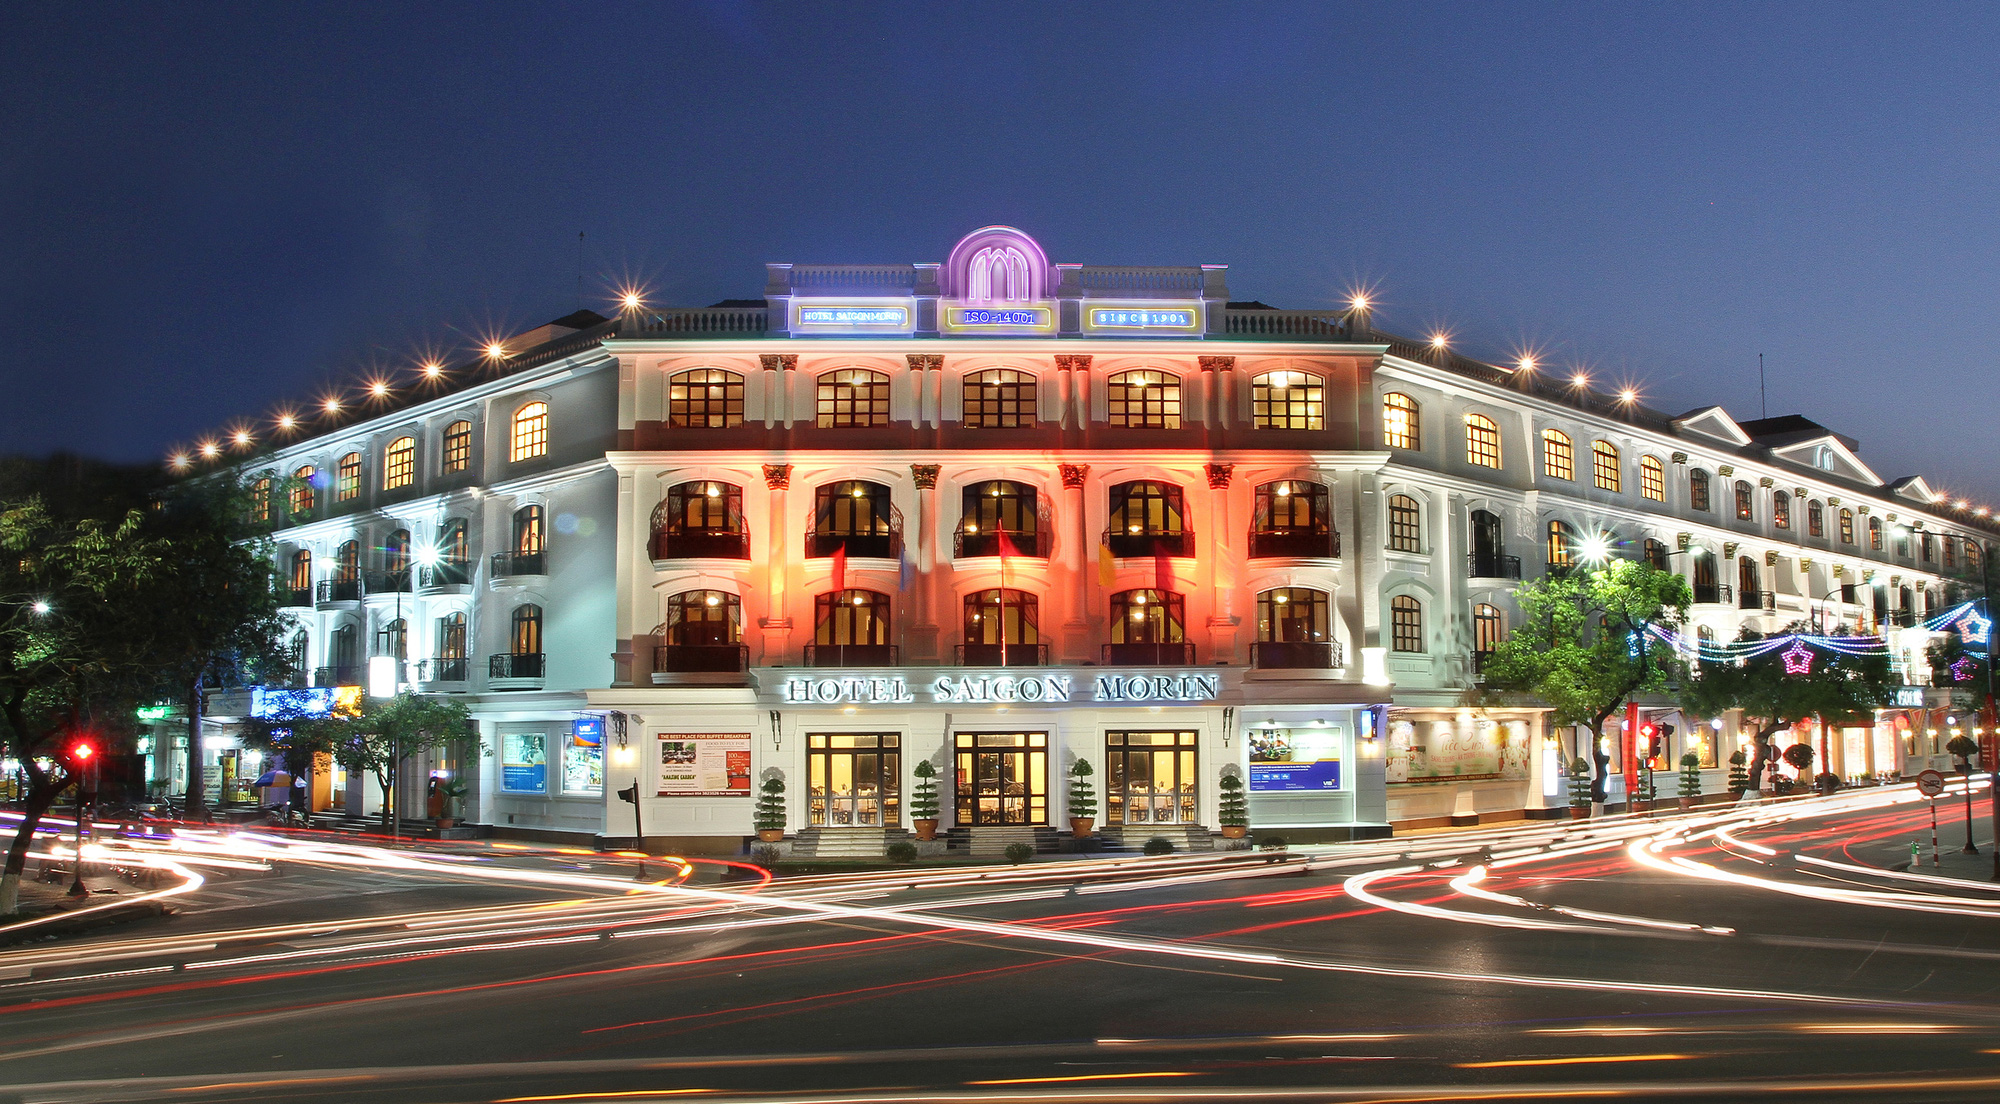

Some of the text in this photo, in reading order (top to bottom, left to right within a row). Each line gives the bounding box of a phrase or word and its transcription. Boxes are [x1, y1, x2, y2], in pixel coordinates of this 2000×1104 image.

[804, 311, 903, 321] HOTEL SAIGON MORIN
[1100, 313, 1187, 323] SINCE 1901
[785, 675, 1218, 703] HOTEL SAIGON MORIN
